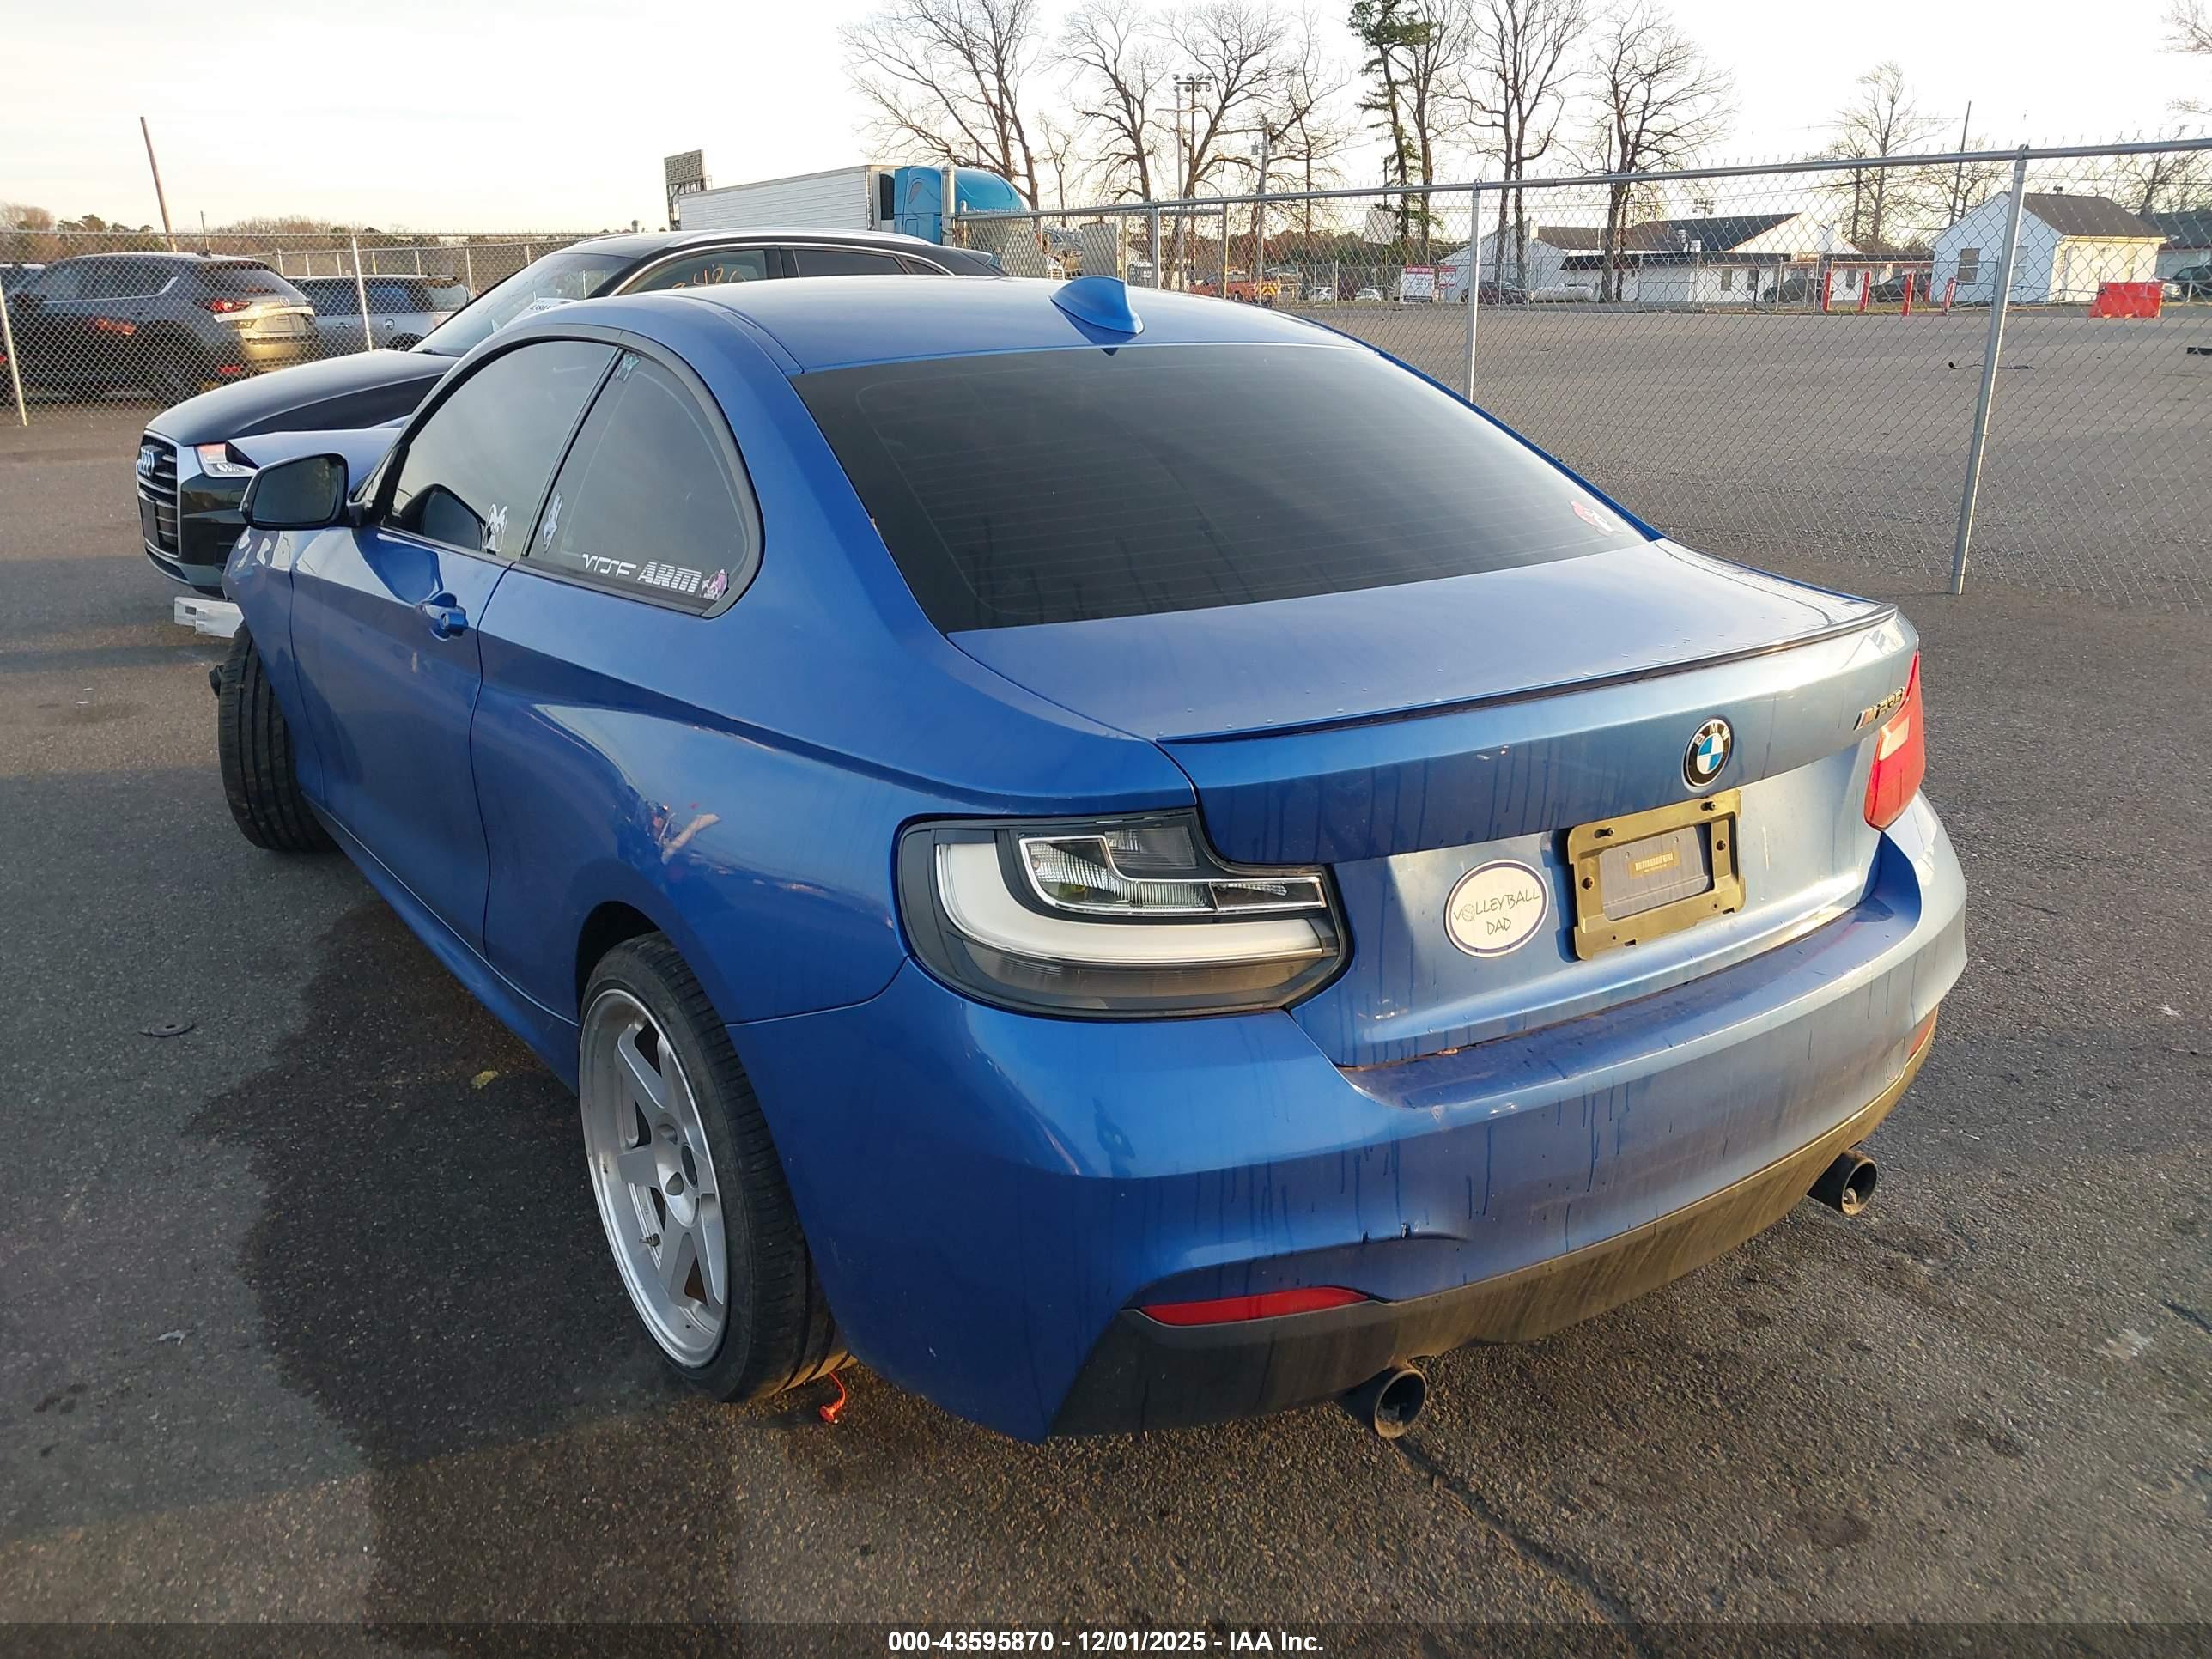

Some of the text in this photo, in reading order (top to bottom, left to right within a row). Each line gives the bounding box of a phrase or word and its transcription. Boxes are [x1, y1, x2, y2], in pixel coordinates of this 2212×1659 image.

[637, 561, 702, 592] ARM
[1694, 722, 1730, 746] BMW
[1486, 916, 1512, 936] DAD
